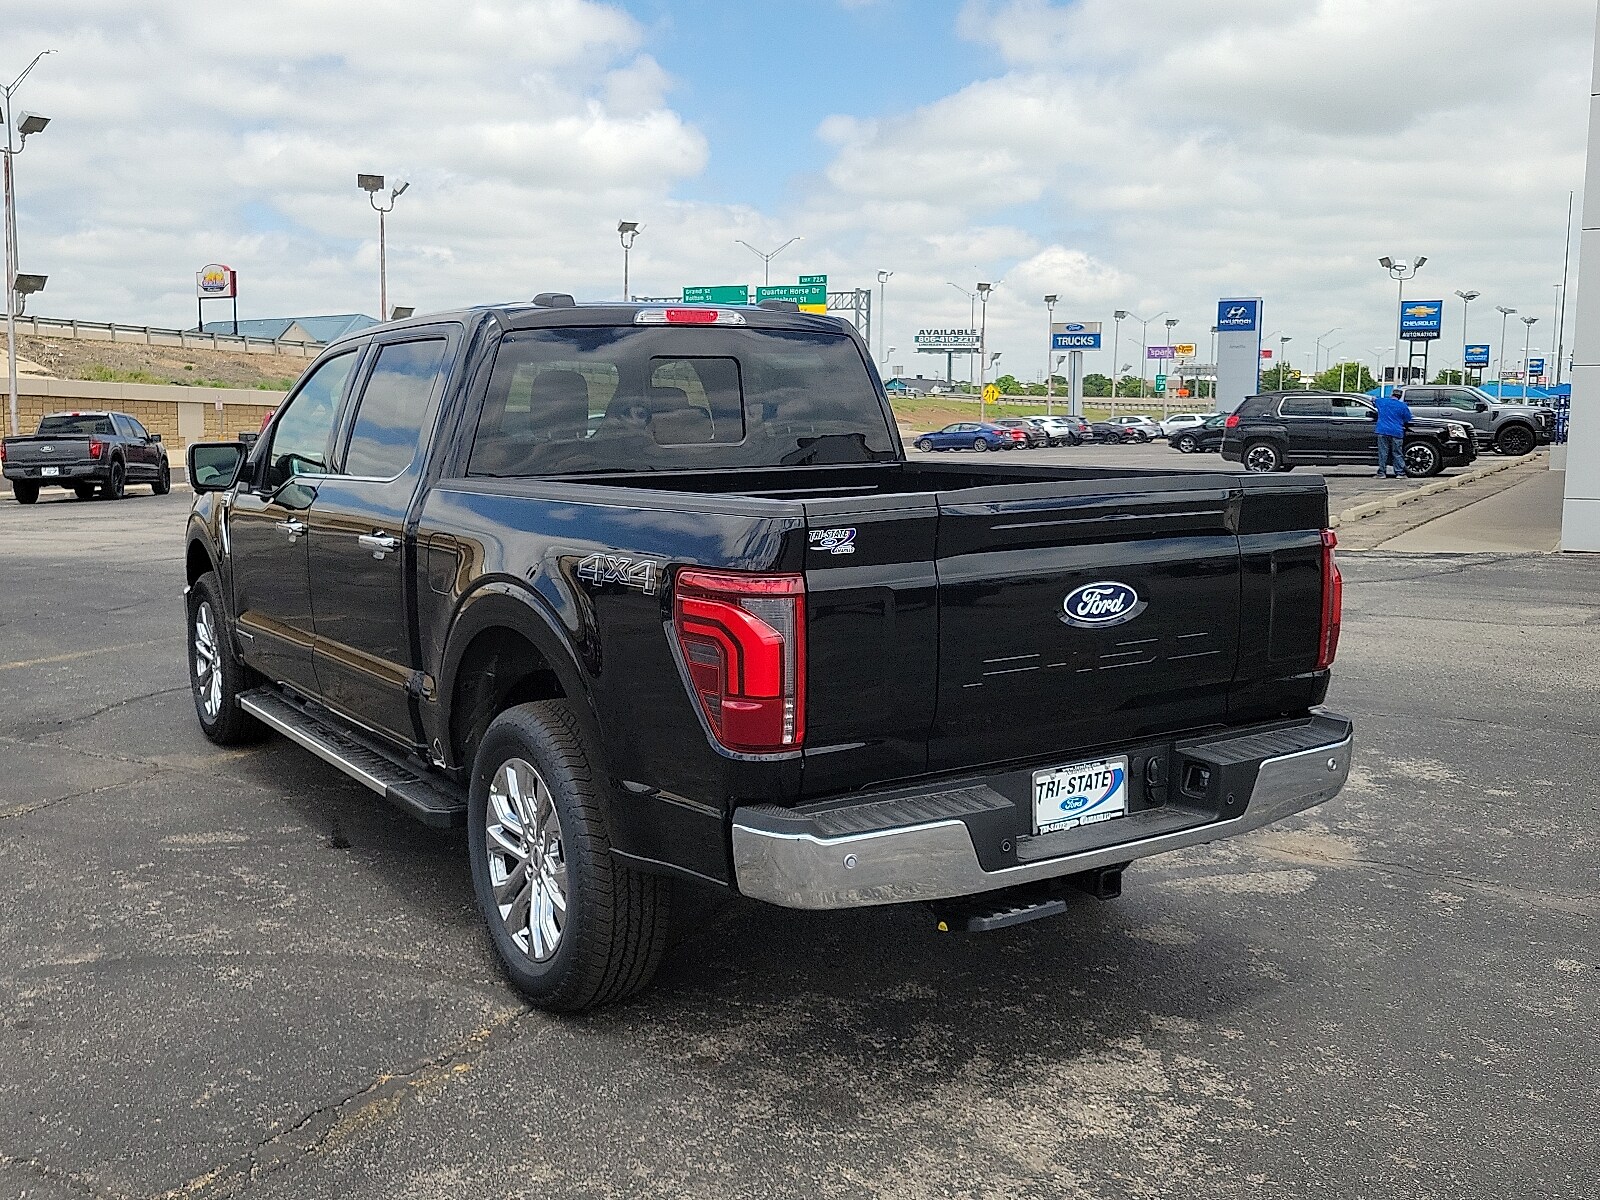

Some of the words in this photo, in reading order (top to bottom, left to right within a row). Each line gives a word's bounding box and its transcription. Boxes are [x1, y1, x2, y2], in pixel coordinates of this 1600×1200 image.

[761, 288, 788, 296] Quarter
[1056, 336, 1095, 347] TRUCKS
[809, 529, 848, 541] TRI-STATE
[1077, 588, 1126, 616] Ford
[1035, 770, 1112, 805] TRI-STATE
[1064, 797, 1084, 810] Ford
